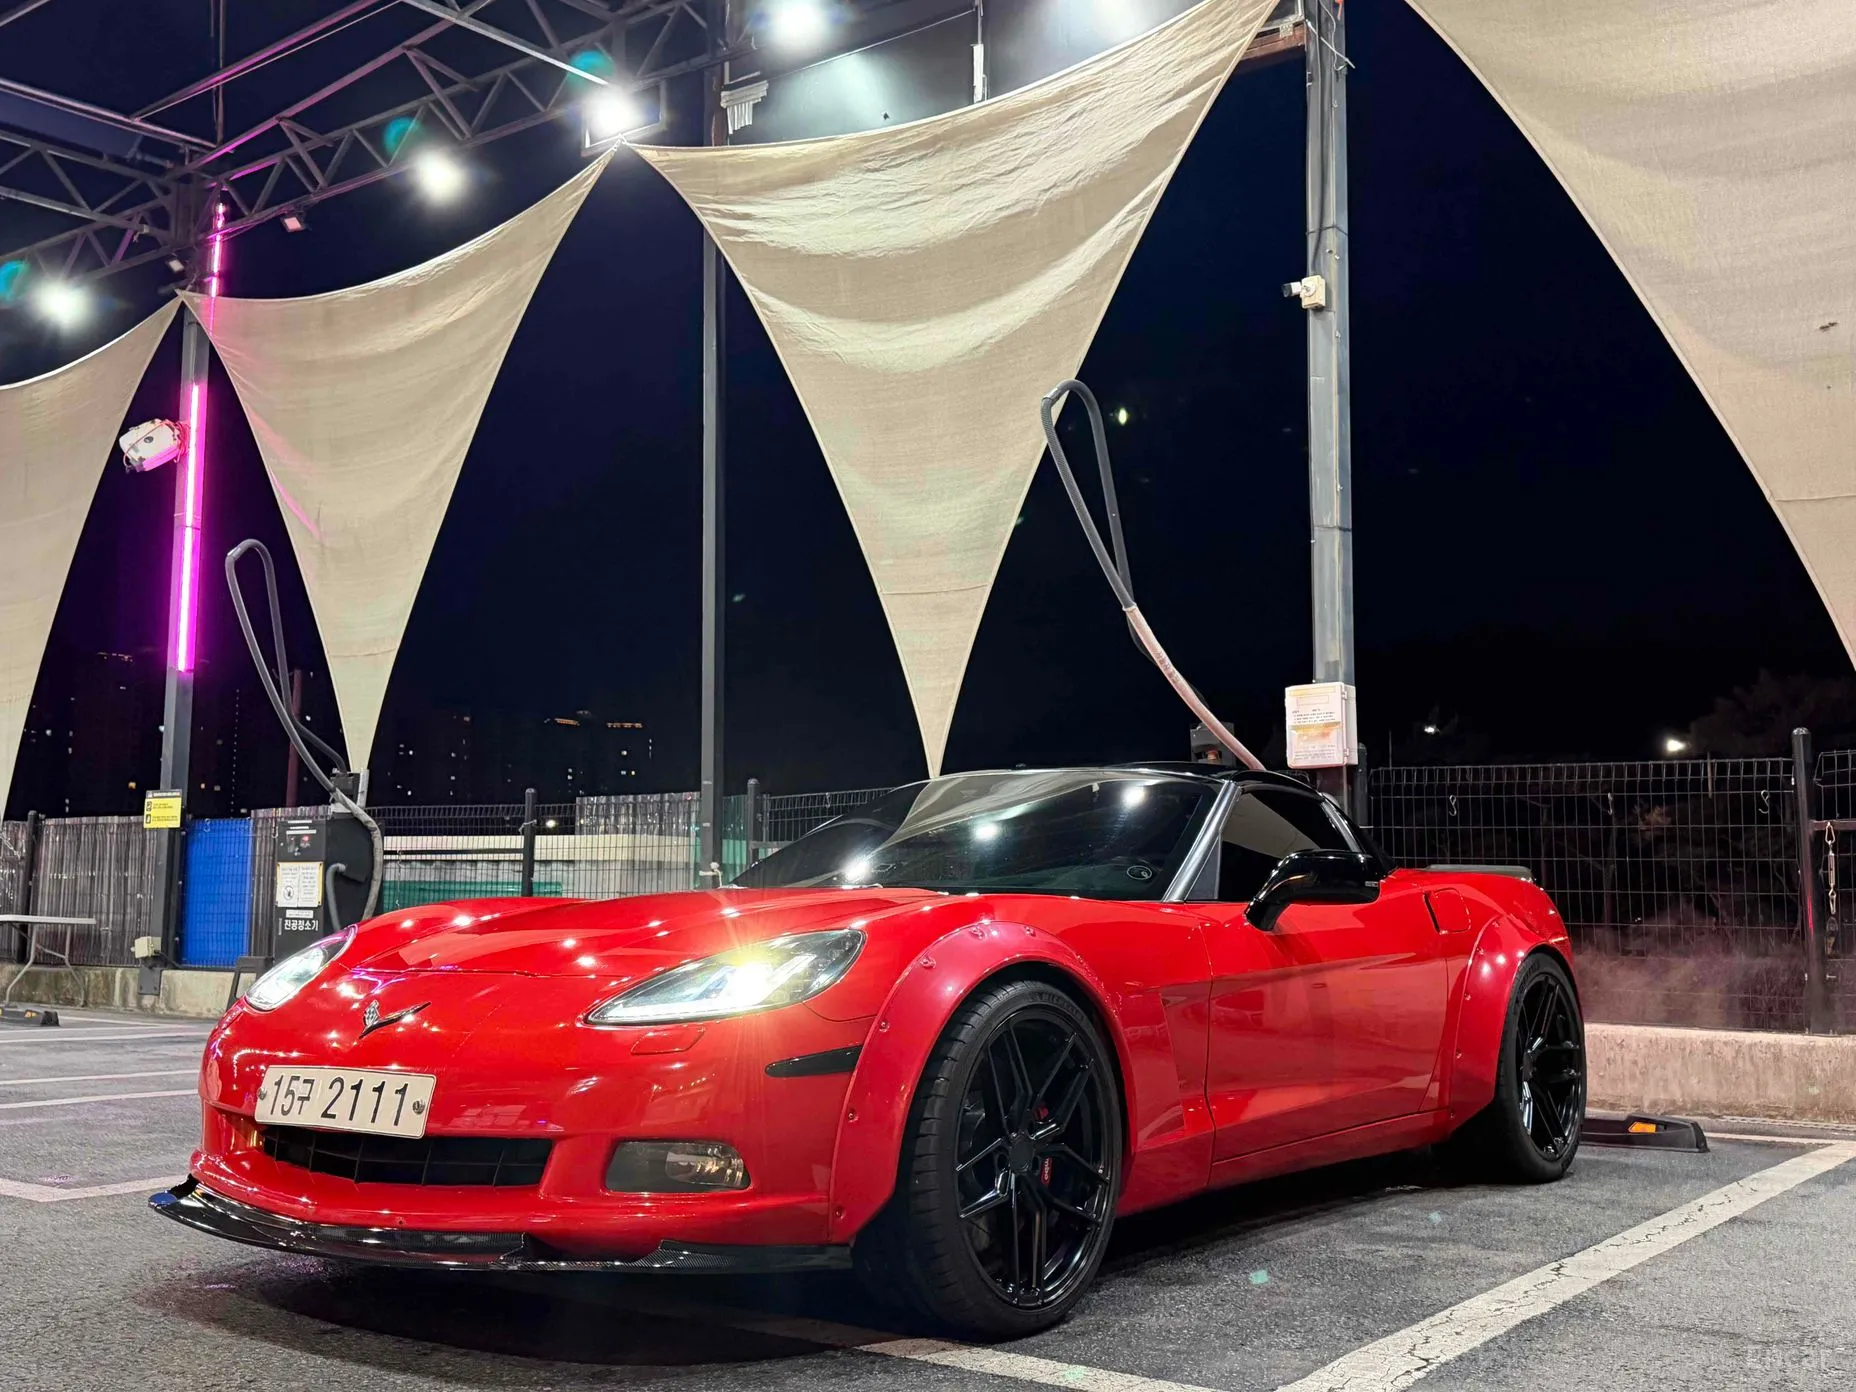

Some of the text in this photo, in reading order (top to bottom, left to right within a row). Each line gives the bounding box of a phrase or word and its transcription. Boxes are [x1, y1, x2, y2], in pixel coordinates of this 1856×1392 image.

[284, 919, 319, 931] 진공청소기
[270, 1074, 409, 1126] 15구 2111
